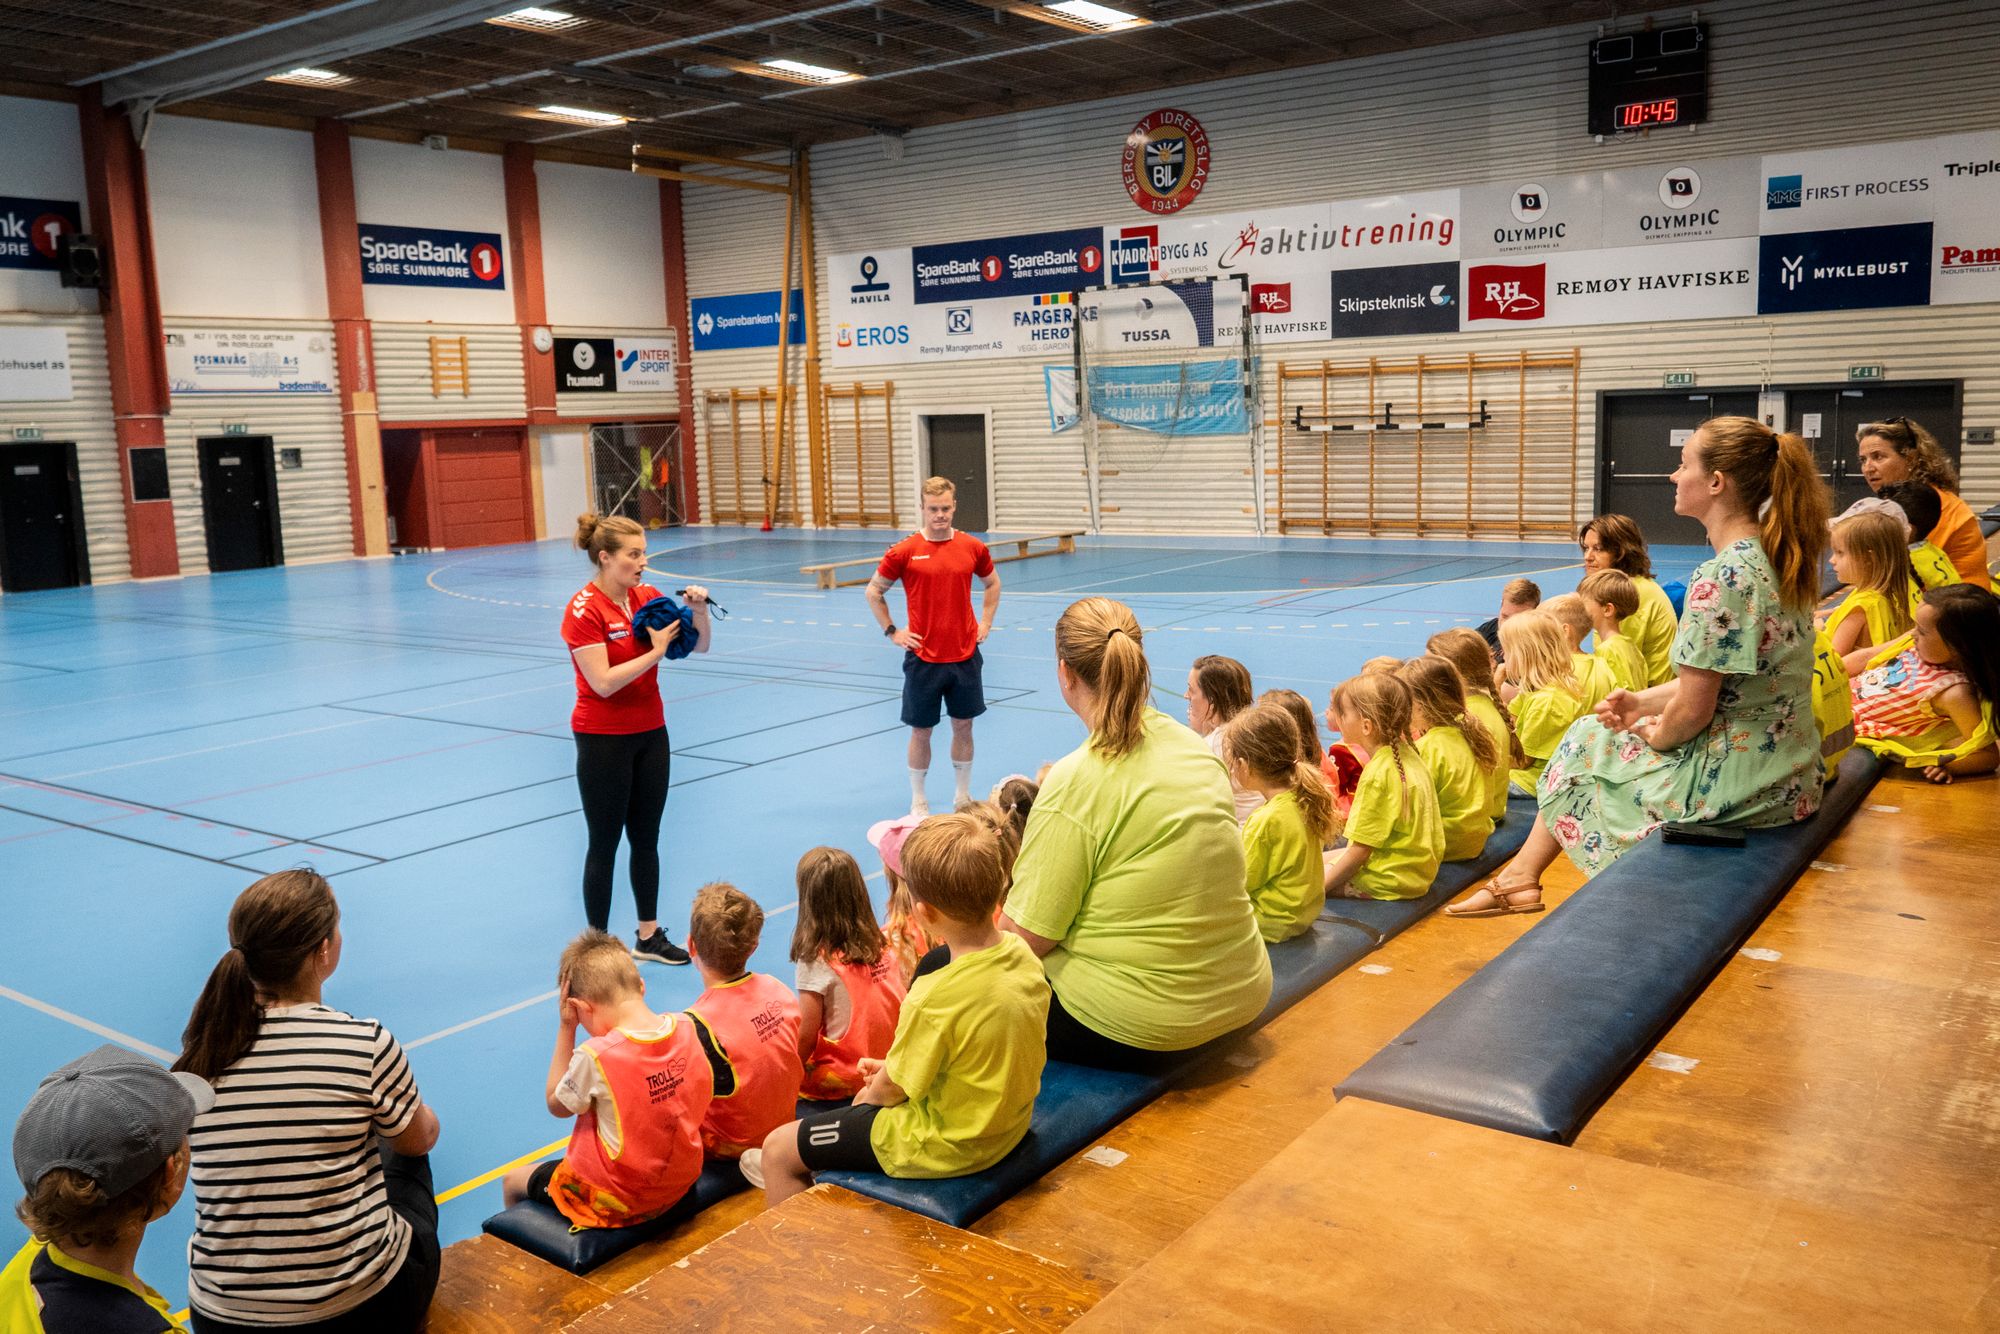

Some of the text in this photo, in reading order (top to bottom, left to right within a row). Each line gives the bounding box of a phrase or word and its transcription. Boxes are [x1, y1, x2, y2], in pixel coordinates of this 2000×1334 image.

[1624, 100, 1676, 125] 10:45
[1160, 112, 1207, 191] IDRETTSLAG
[1153, 165, 1177, 188] BIL
[1767, 178, 1929, 204] MMC FIRST PROCESS
[1152, 198, 1178, 211] 1944
[1639, 208, 1720, 231] OLYMPIC
[43, 221, 61, 251] 1
[1260, 212, 1454, 255] aktivtrening
[1493, 222, 1566, 243] OLYMPIC
[360, 236, 492, 274] SpareBank 1
[1008, 248, 1094, 271] SpareBank 1
[1193, 241, 1208, 258] AS
[367, 262, 470, 278] SØRE SUNNMØRE
[916, 258, 995, 279] SpareBank 1
[1012, 265, 1079, 279] SØRE SUNNMØRE
[1814, 261, 1909, 279] MYKLEBUST
[920, 274, 981, 287] SØRE SUNNMØRE
[1485, 280, 1521, 301] RH
[1556, 269, 1750, 296] REMØY HAVFISKE
[851, 293, 891, 304] HAVILA
[1339, 293, 1426, 315] Skipsteknisk
[716, 311, 798, 330] Sparebanken Mre
[953, 314, 967, 329] R
[1014, 305, 1098, 327] FARGERKE
[856, 324, 910, 347] EROS
[1121, 328, 1171, 342] TUSSA
[1264, 321, 1328, 334] HAVFISKE
[639, 349, 670, 360] INTER
[919, 340, 1003, 355] Remøy Management AS
[51, 361, 65, 370] as
[193, 353, 247, 365] FOSNAVÅG
[640, 361, 671, 373] SPORT
[750, 1009, 775, 1031] TROLL
[645, 1068, 675, 1091] TROLL
[809, 1120, 841, 1146] 10
